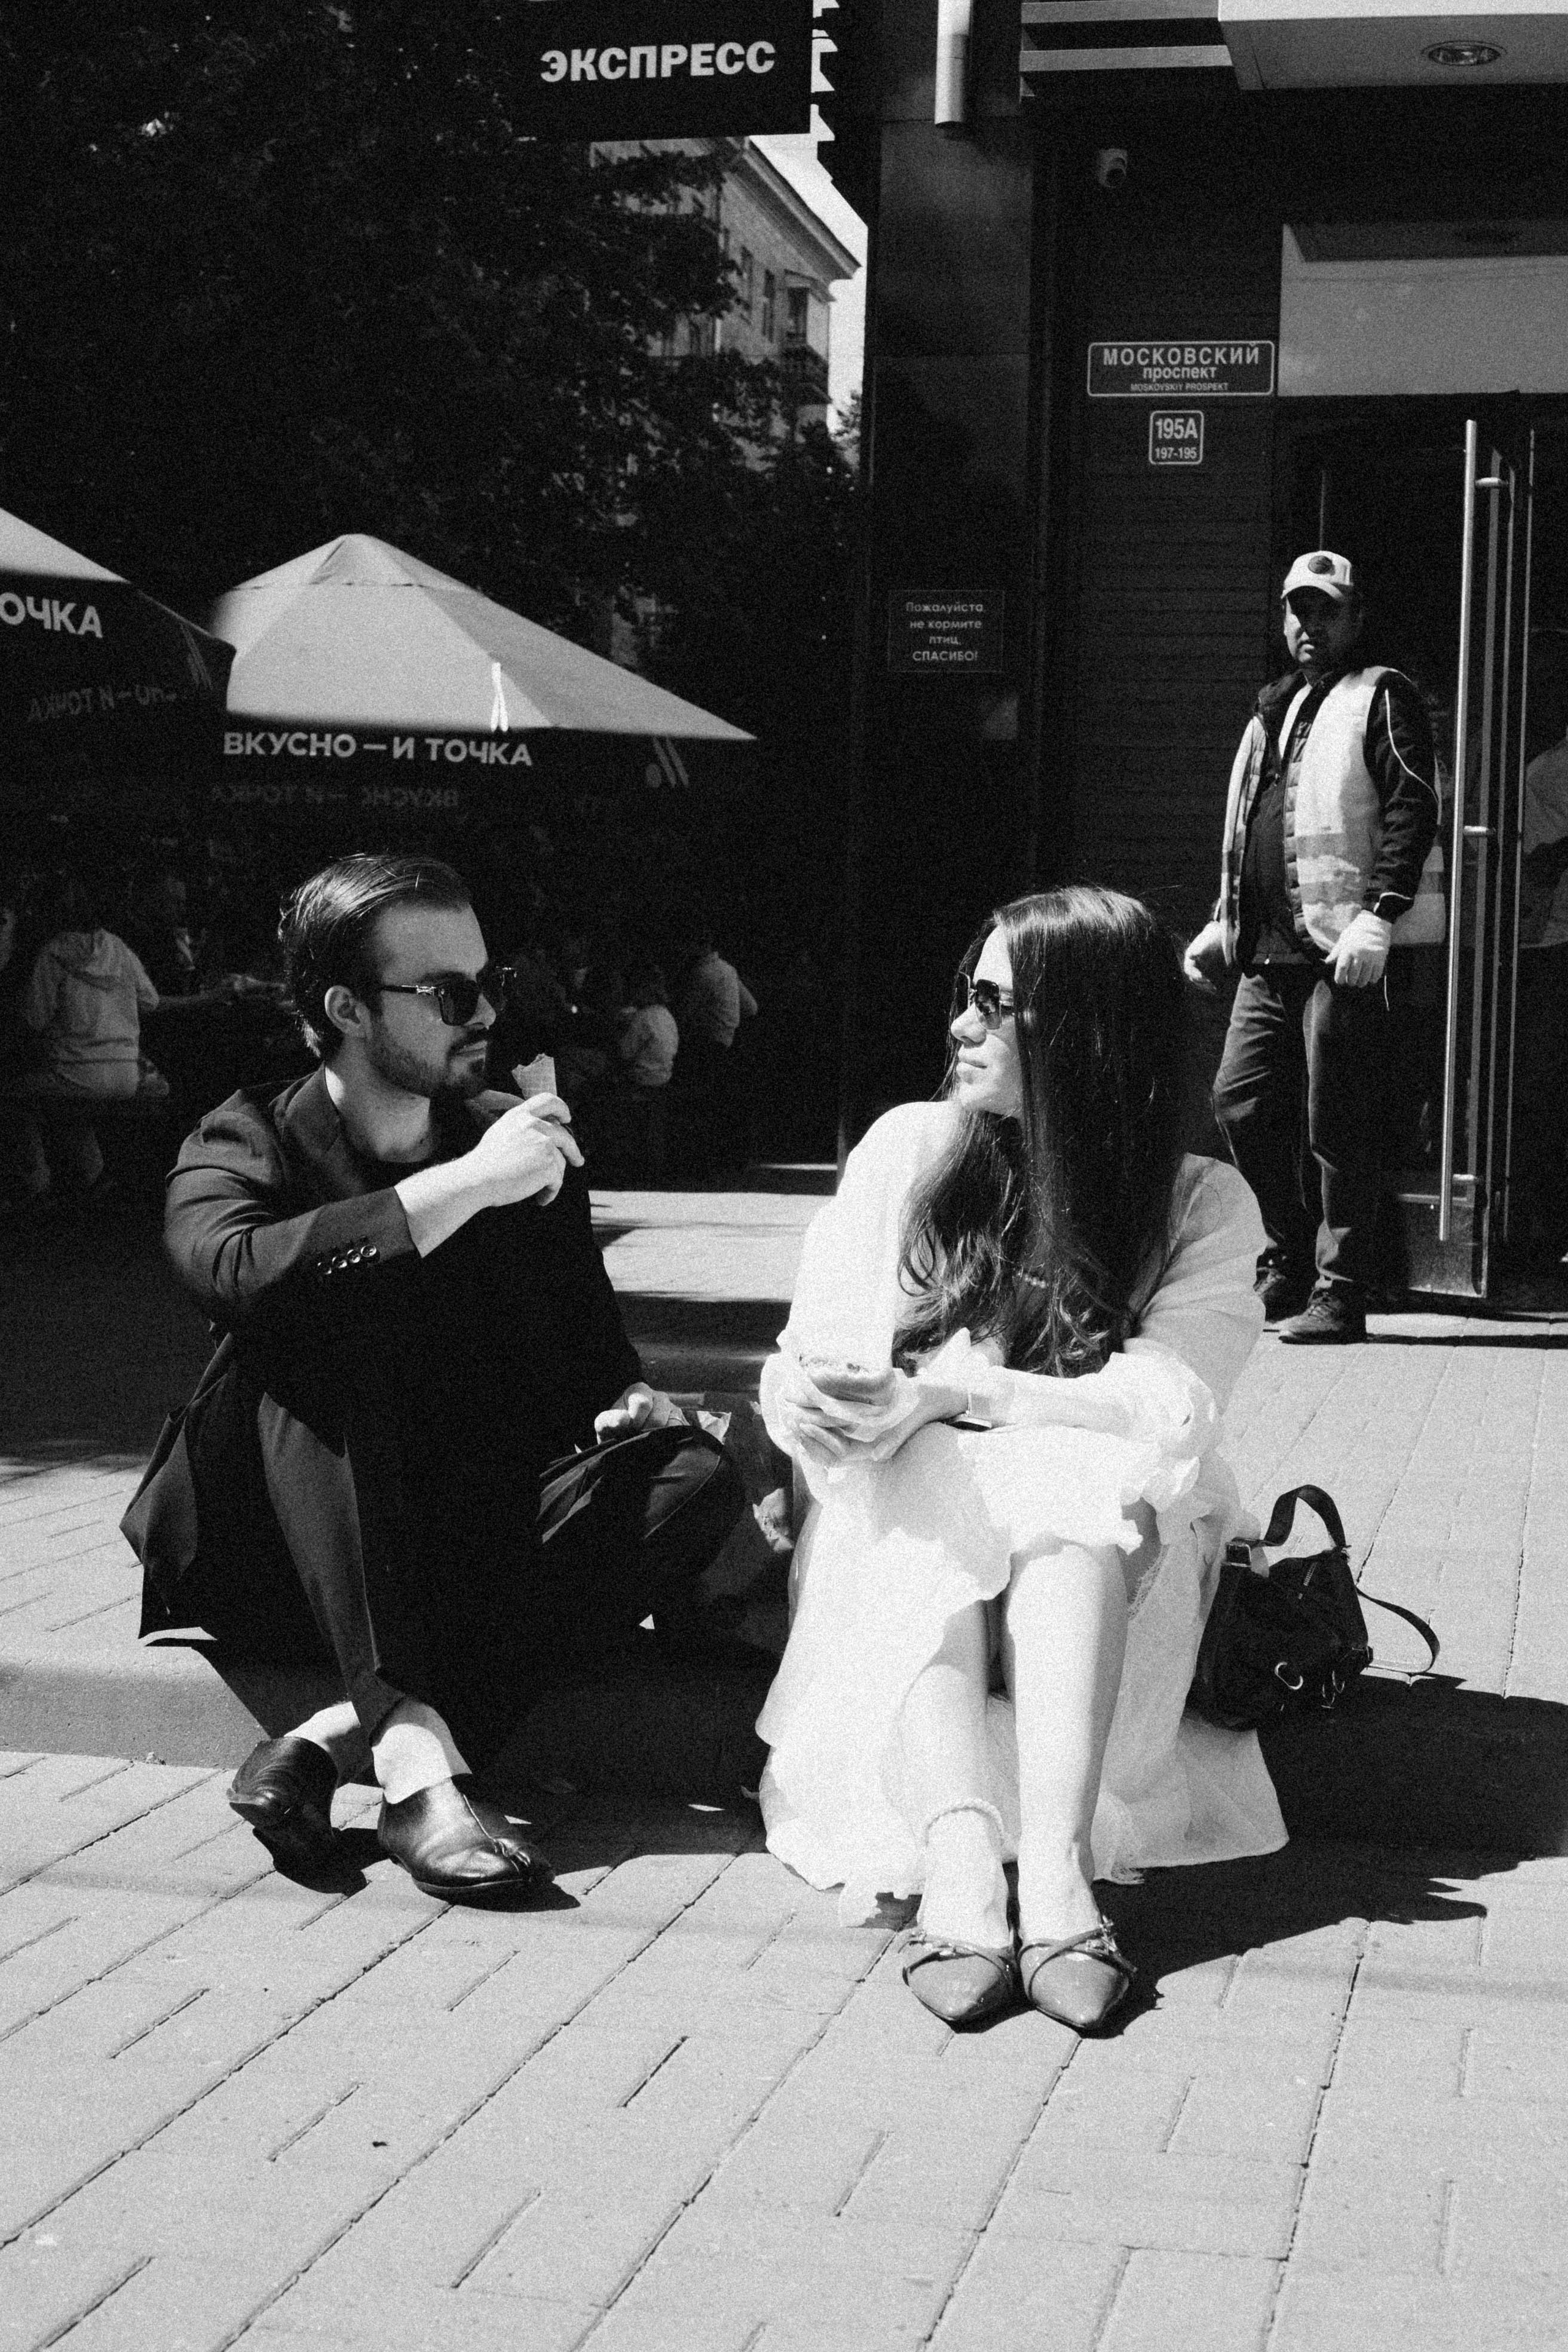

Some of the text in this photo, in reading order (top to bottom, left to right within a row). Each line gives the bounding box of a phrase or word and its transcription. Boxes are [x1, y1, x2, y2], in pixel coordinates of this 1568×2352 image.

[540, 41, 776, 82] ЭКСПРЕСС
[1103, 342, 1259, 366] МОСКОВСКИЙ
[1142, 367, 1217, 382] проспект
[1131, 382, 1229, 391] MOSKOVSKIY PROSPEKT
[1155, 447, 1197, 459] 197-195
[910, 620, 982, 631] не кормите
[913, 650, 979, 662] СПАСИБО!
[223, 732, 357, 758] ВКУСНО
[425, 737, 533, 766] ТОЧКА
